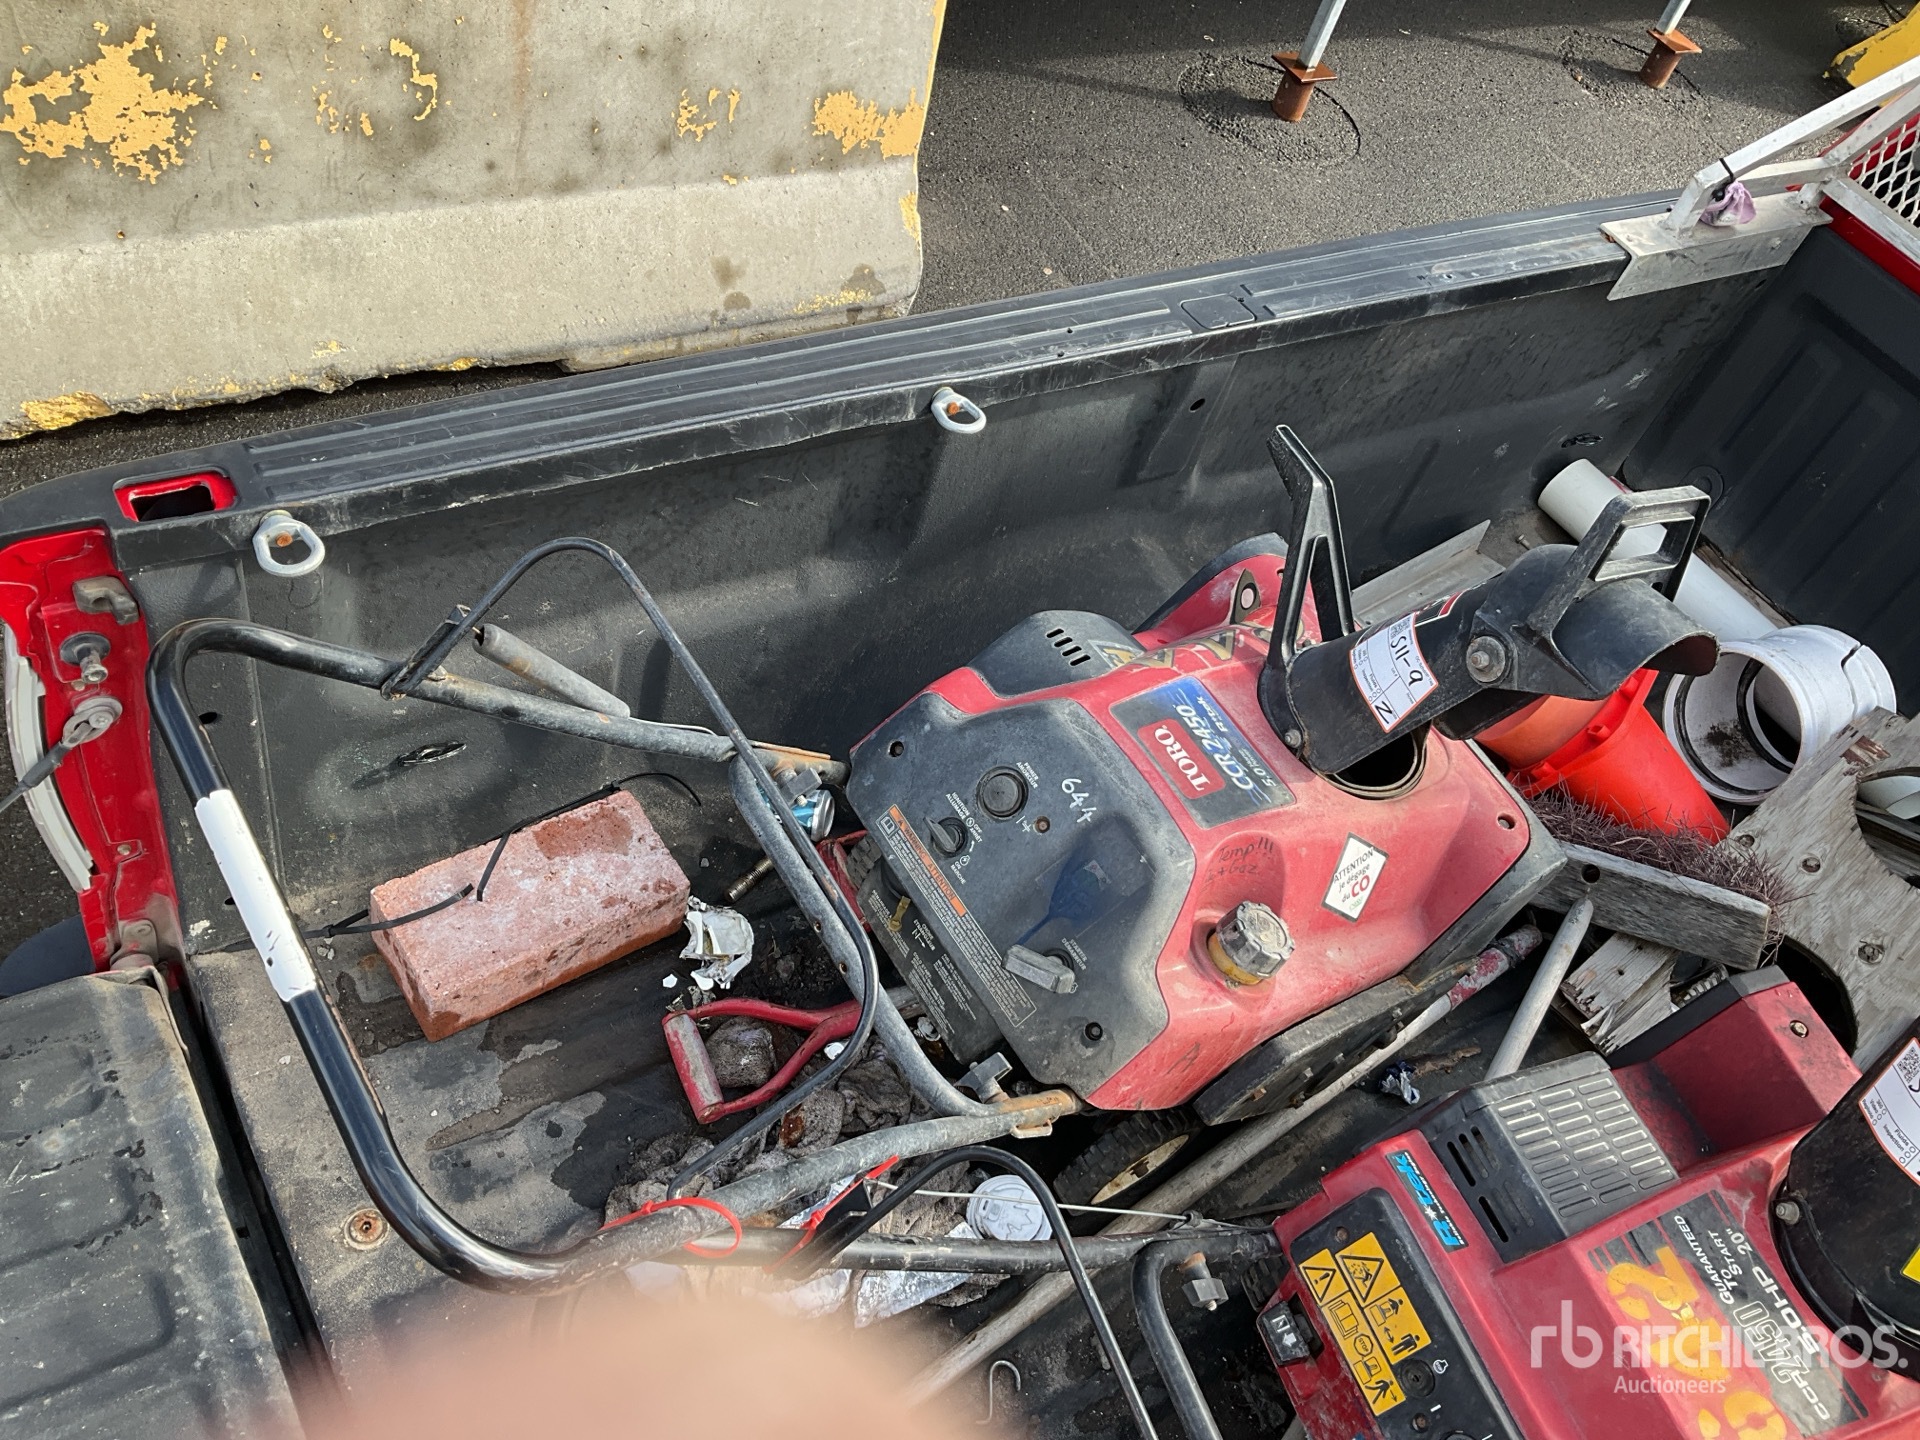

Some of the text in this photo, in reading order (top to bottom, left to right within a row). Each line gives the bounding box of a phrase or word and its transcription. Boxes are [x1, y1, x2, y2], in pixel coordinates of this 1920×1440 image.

[1154, 726, 1210, 791] TORO
[1176, 705, 1253, 790] CCR 2450
[1016, 762, 1038, 789] AMORCEUR
[1024, 762, 1039, 781] PRIMER
[1254, 768, 1276, 787] 5.0
[946, 793, 967, 819] ALLUMAGE
[952, 792, 970, 815] IGNITION
[1062, 778, 1096, 823] 644
[903, 828, 956, 900] WARNING ATTENTION
[950, 864, 966, 885] MARCHE
[1333, 849, 1374, 884] ATTENTION
[1351, 875, 1370, 897] CO
[1883, 1124, 1905, 1152] Inspection
[1894, 1129, 1909, 1147] Fluids
[1674, 1215, 1735, 1305] GUARANTEED
[1708, 1230, 1743, 1277] START
[1719, 1269, 1739, 1291] TO
